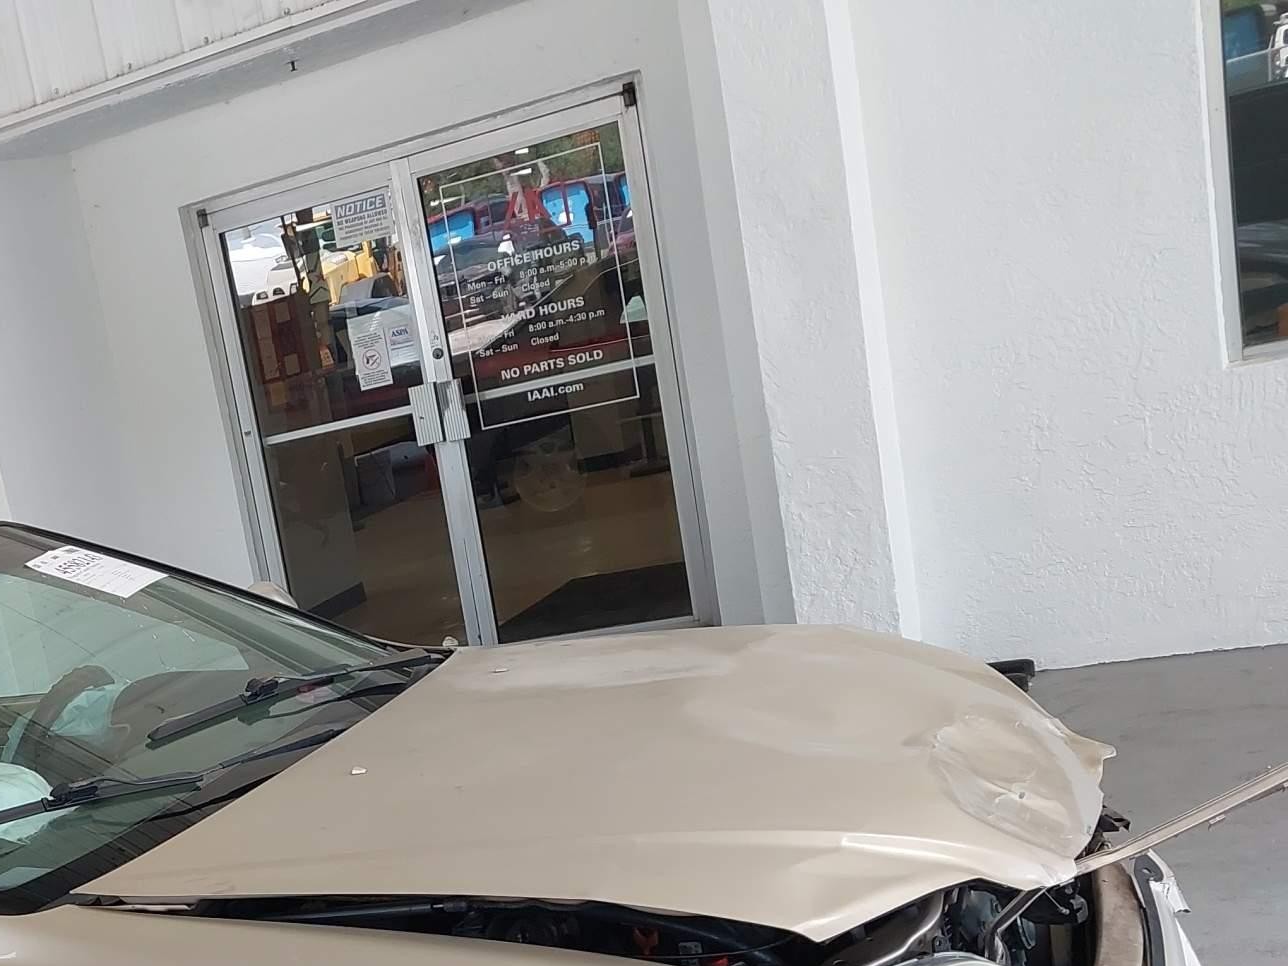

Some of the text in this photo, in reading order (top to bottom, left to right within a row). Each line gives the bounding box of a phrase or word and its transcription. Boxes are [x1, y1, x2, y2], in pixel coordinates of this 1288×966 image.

[337, 195, 384, 218] NOTICE
[487, 240, 581, 272] OFFICE HOURS
[467, 280, 487, 292] Mon
[494, 275, 505, 286] Fri
[519, 267, 538, 279] 8:00
[470, 294, 485, 304] Sat
[492, 289, 509, 300] Sun
[521, 278, 550, 292] Closed
[539, 296, 585, 316] HOURS
[504, 328, 515, 339] Fri
[528, 321, 547, 333] 8:00
[479, 347, 494, 358] Sat
[501, 343, 519, 353] Sun
[531, 332, 560, 346] Closed
[500, 349, 604, 381] NO PARTS SOLD
[527, 382, 585, 402] IAAI.com
